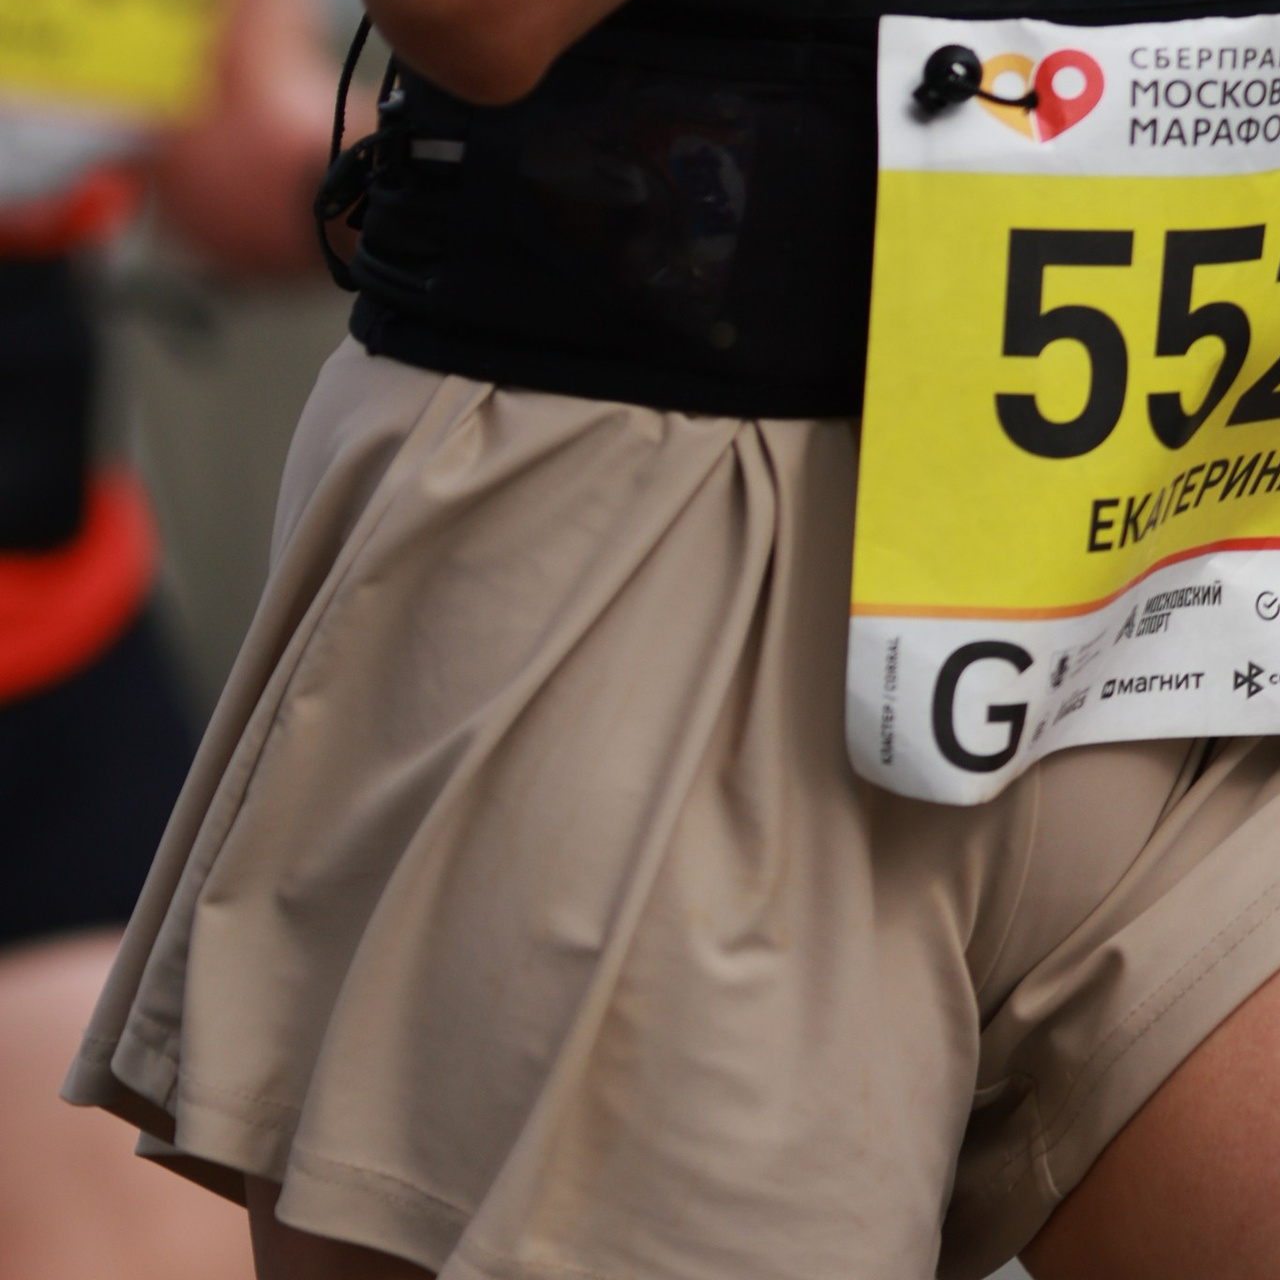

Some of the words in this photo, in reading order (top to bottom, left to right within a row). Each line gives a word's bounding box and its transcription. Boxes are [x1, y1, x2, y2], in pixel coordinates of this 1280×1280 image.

[1143, 580, 1222, 615] МОСКОВСКИЙ
[1136, 612, 1172, 637] СПОРТ
[931, 639, 1034, 774] G
